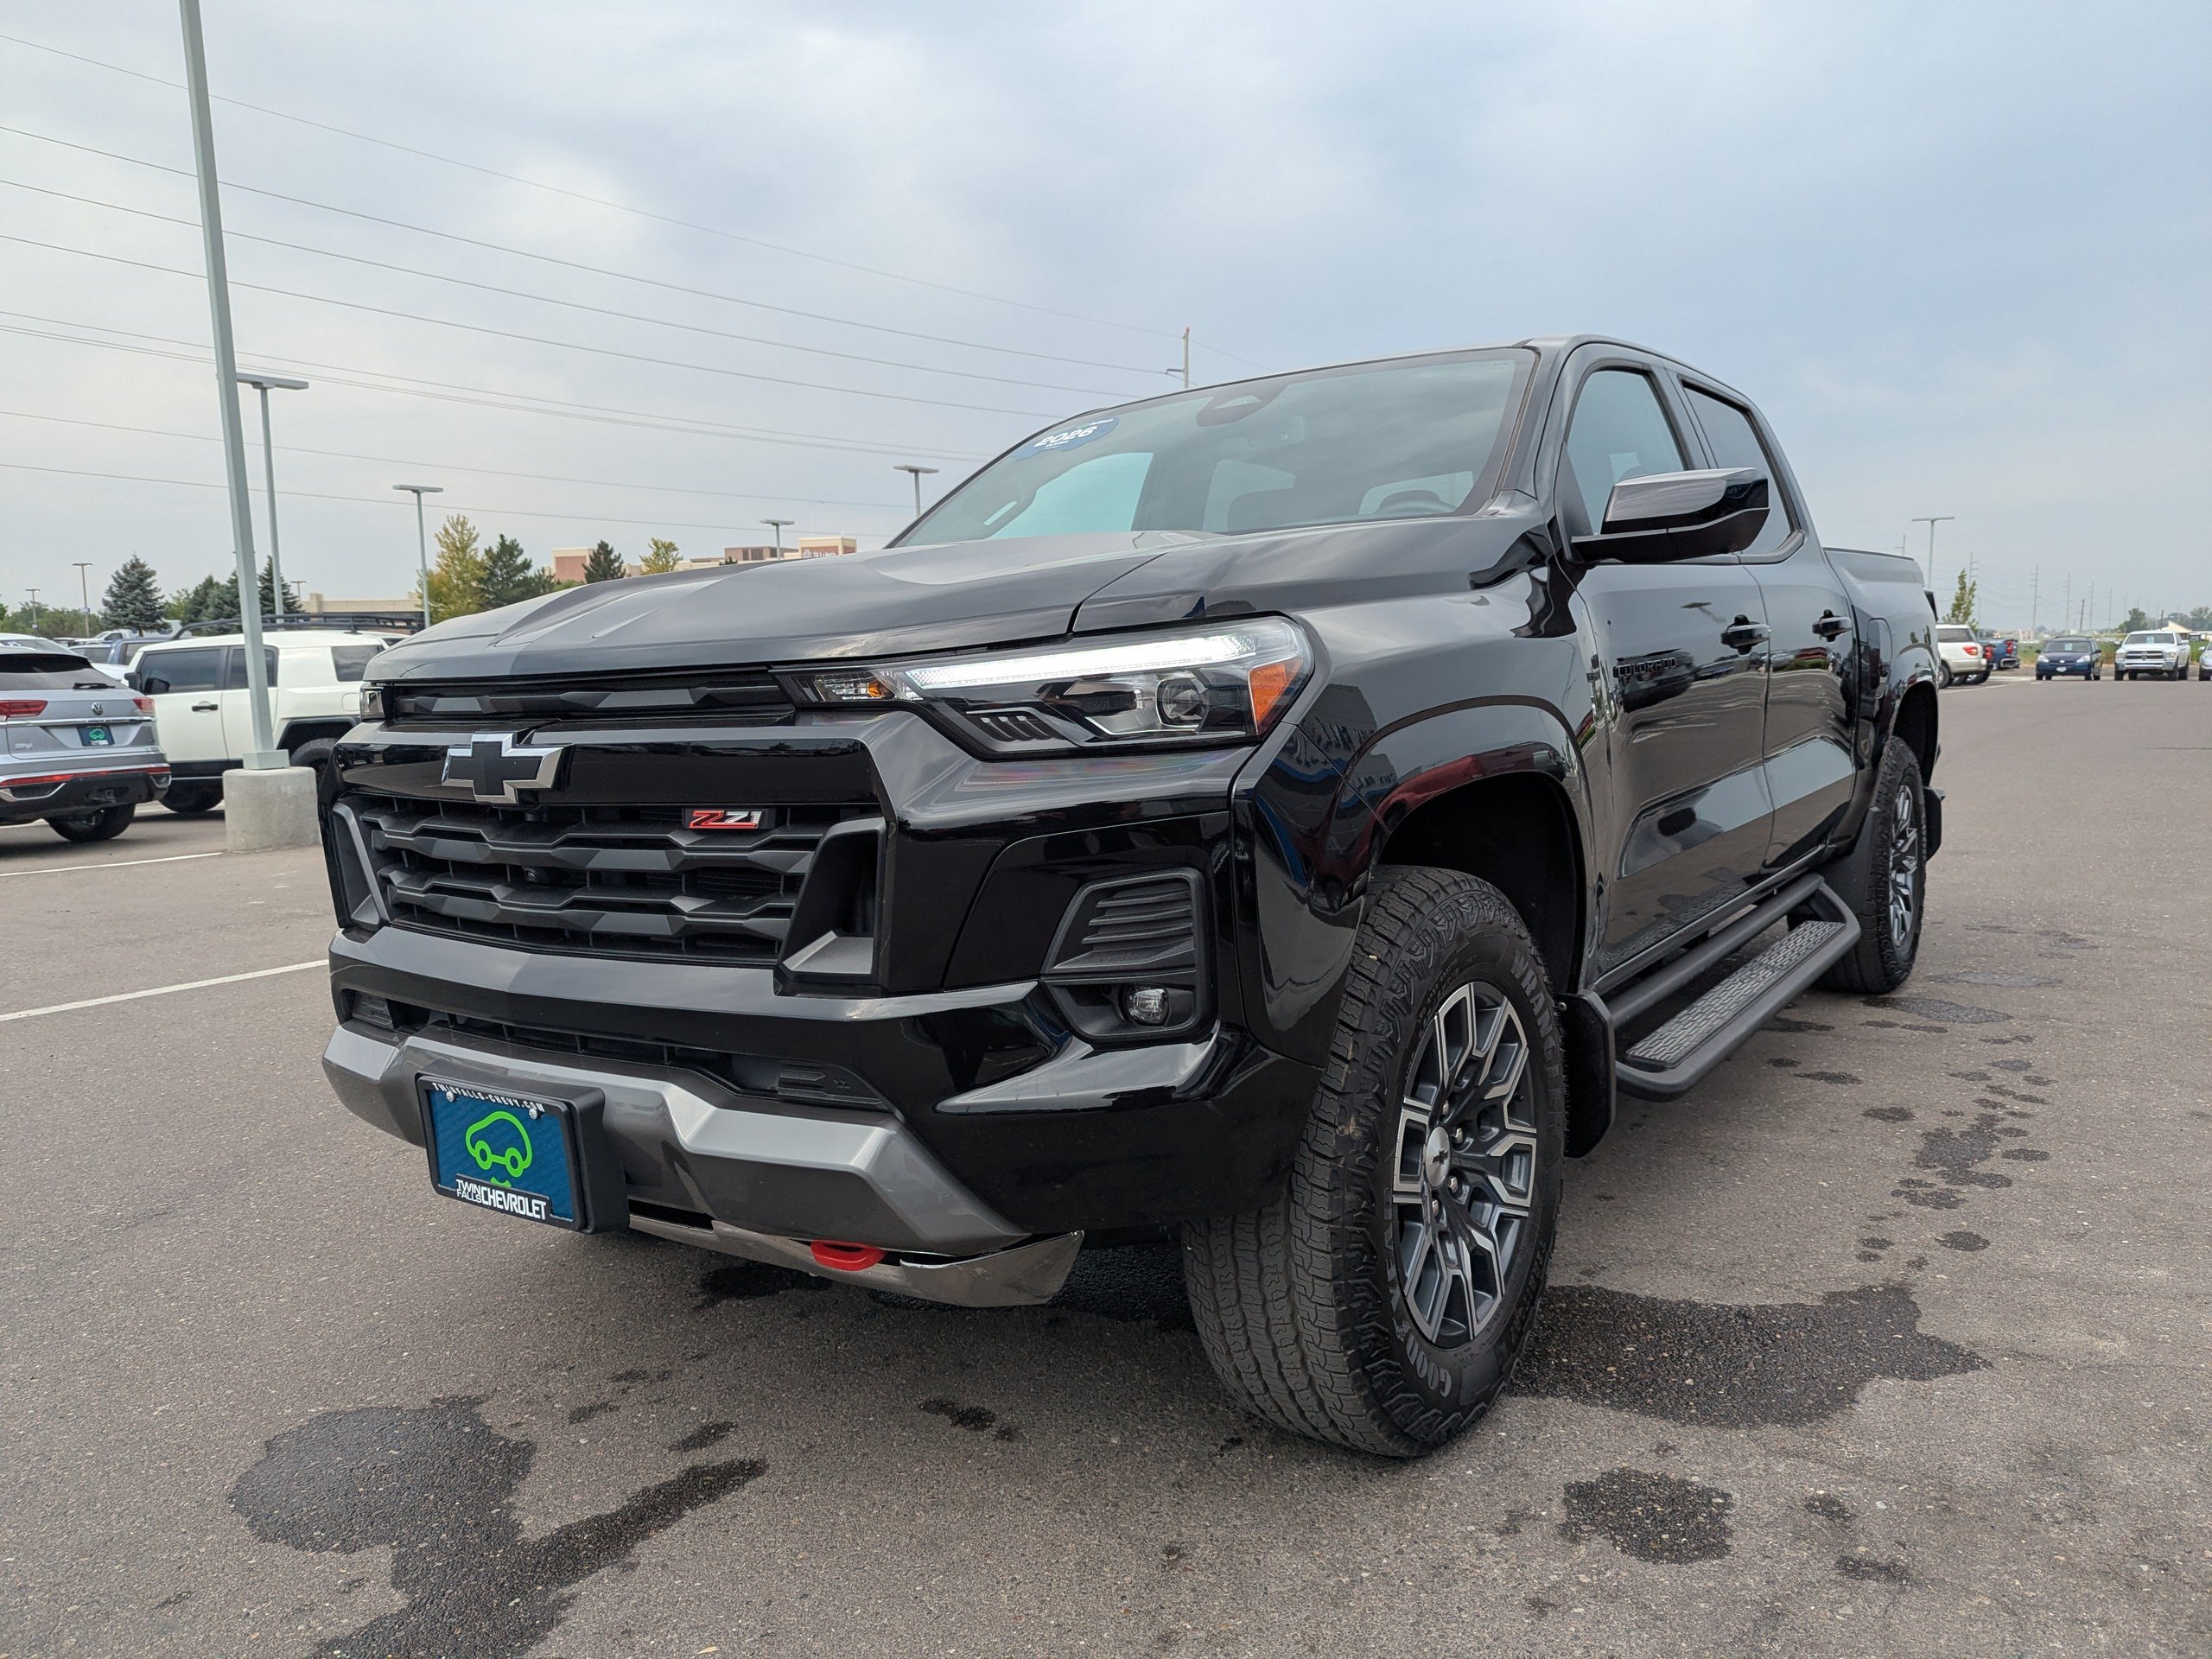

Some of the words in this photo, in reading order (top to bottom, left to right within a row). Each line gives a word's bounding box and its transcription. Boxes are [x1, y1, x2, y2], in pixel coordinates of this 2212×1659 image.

[1034, 425, 1098, 448] 2026
[455, 1179, 481, 1194] TWIN
[456, 1188, 482, 1204] FALLS
[481, 1185, 547, 1220] CHEVROLET
